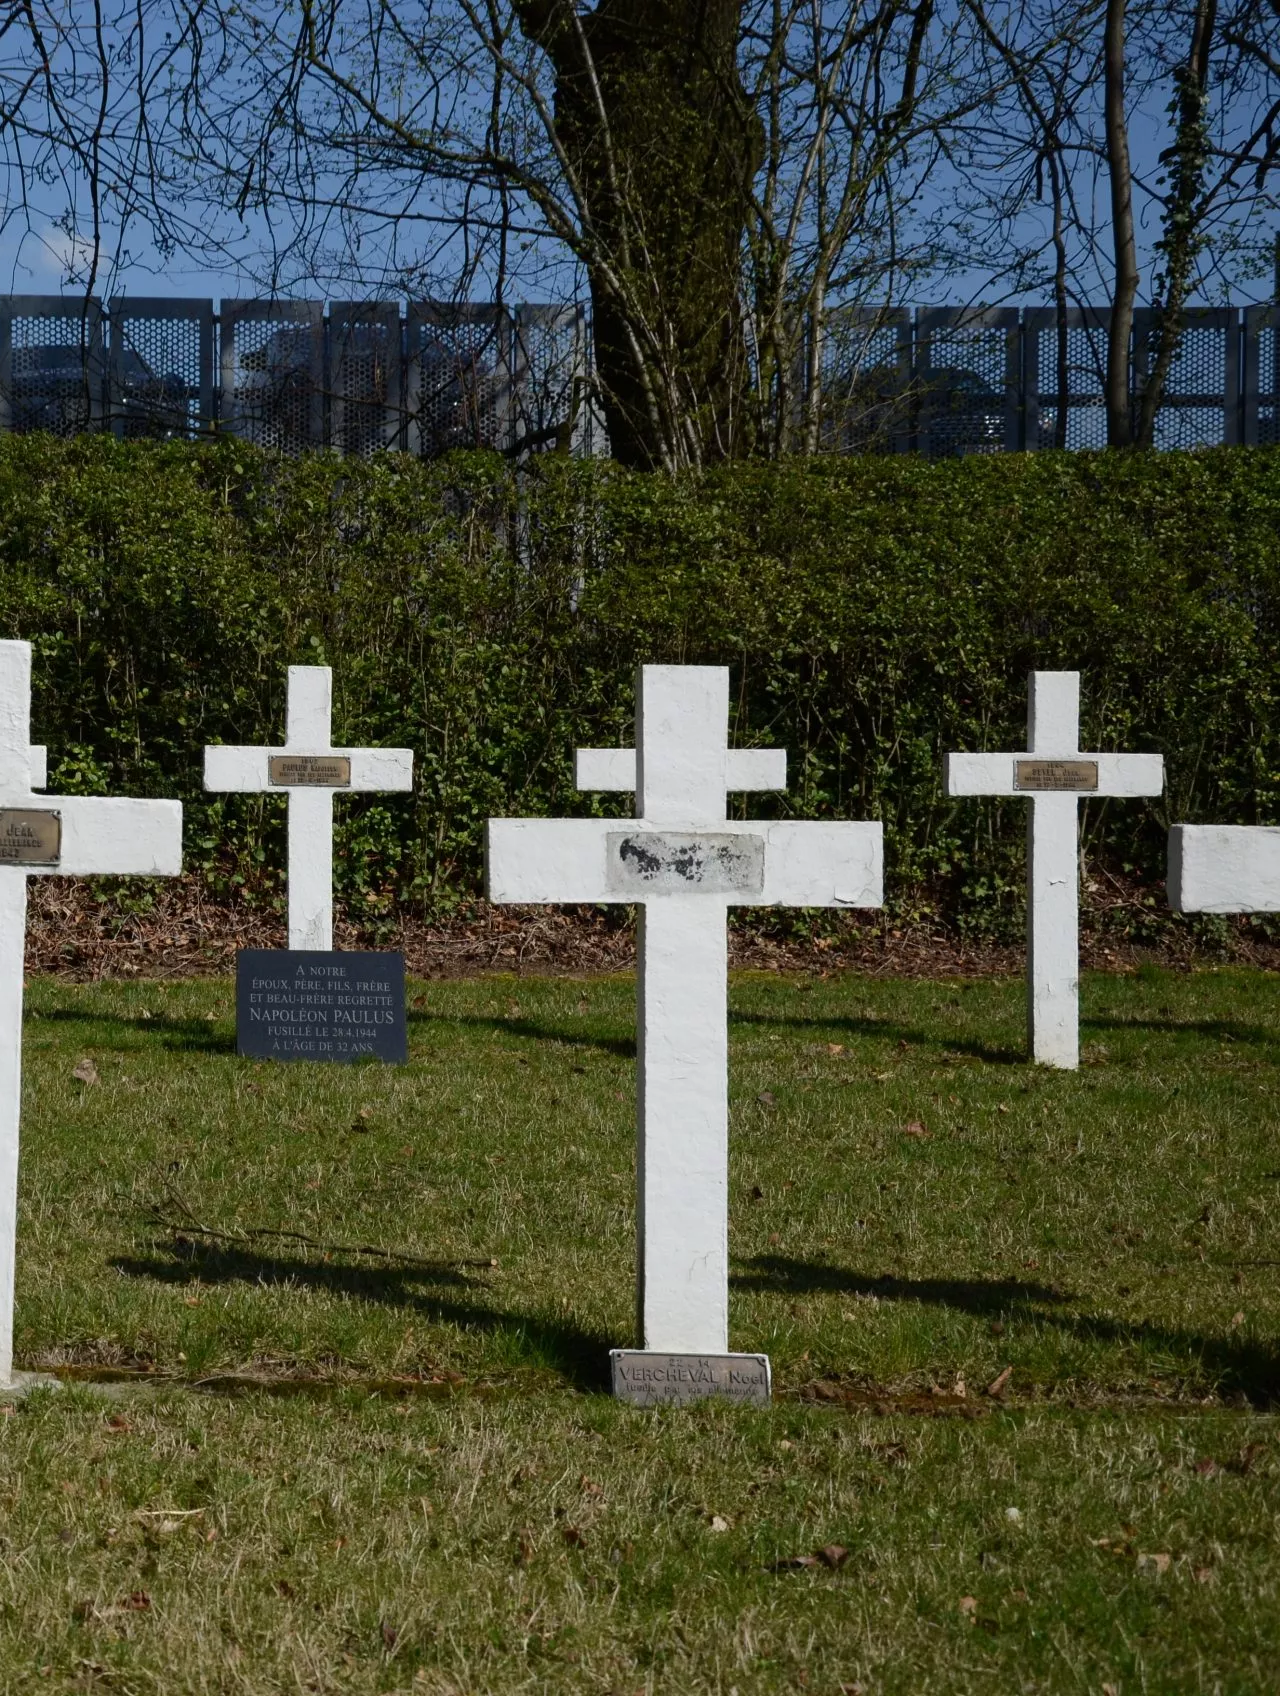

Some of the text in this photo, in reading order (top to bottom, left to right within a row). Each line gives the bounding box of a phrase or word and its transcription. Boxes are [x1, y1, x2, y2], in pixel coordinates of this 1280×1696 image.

[310, 966, 346, 977] NOTRE
[250, 993, 263, 1003] ET
[337, 993, 394, 1006] REGRETTÉ
[249, 1007, 394, 1024] NAPOLÉON PAULUS
[268, 1025, 377, 1038] FUSILLÉ LE 28.4.1944
[319, 1041, 333, 1051] DE
[336, 1042, 348, 1052] 32
[351, 1043, 373, 1052] ANS
[619, 1367, 719, 1384] VERCHEVAL
